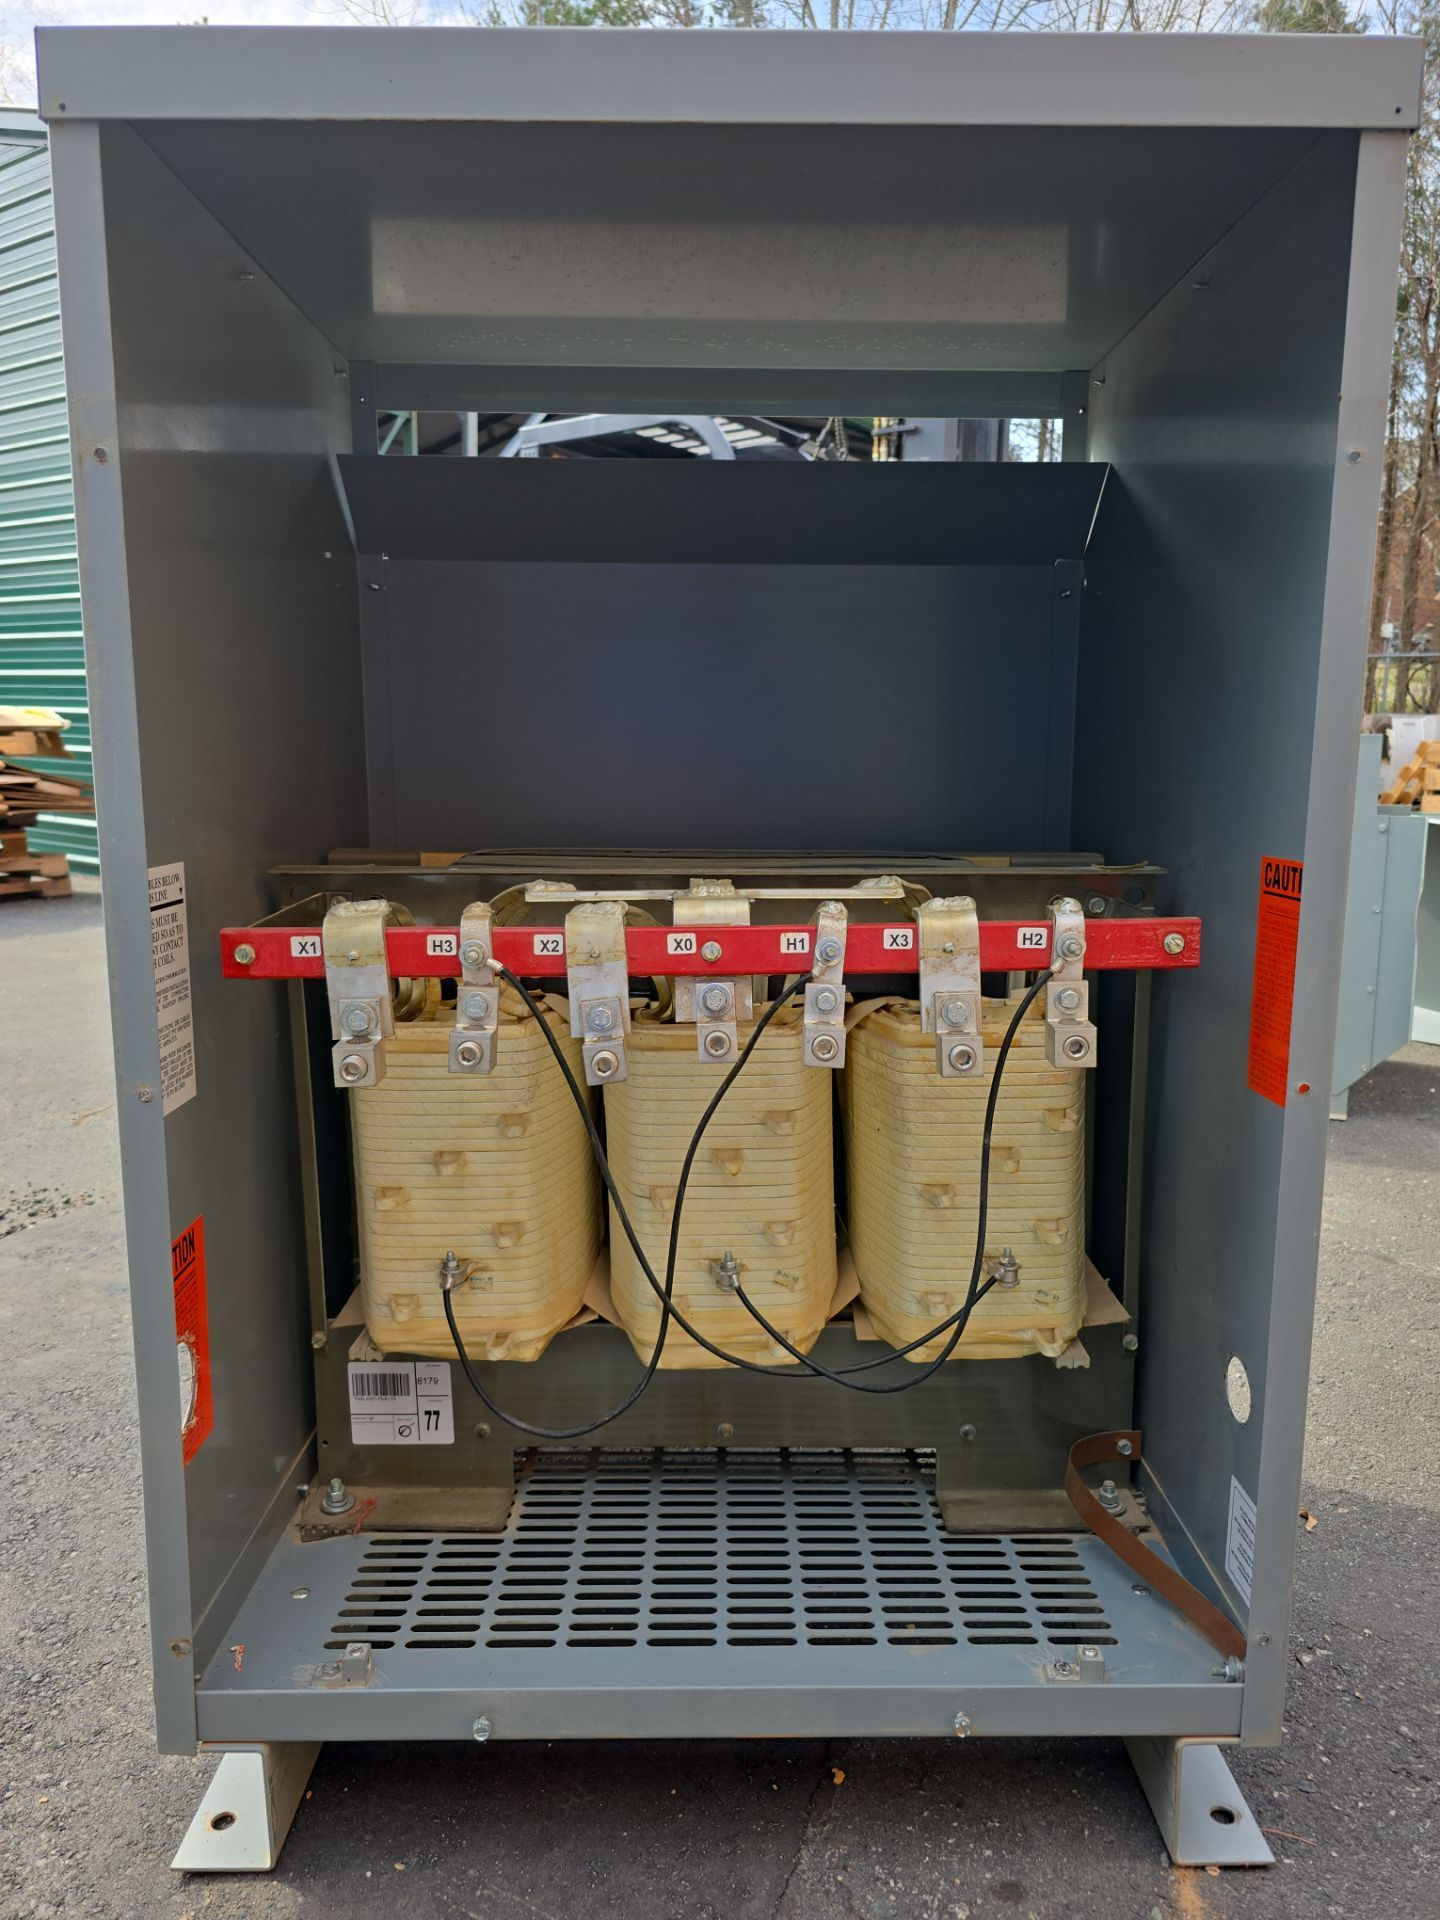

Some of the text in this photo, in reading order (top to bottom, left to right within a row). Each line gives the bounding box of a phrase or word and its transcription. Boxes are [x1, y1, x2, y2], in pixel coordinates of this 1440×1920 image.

[161, 873, 180, 887] BELOW
[154, 889, 168, 902] LINE
[155, 914, 170, 928] MUST
[170, 912, 178, 923] BE
[160, 929, 168, 940] SO
[168, 926, 175, 938] AS
[176, 923, 184, 935] TO
[159, 936, 184, 954] CONTACT
[432, 939, 453, 953] H3
[540, 939, 560, 953] X2
[786, 937, 805, 951] H1
[889, 934, 909, 948] X3
[1022, 932, 1043, 946] H2
[299, 941, 317, 955] X1
[172, 1228, 195, 1272] TION
[424, 1410, 440, 1431] 77
